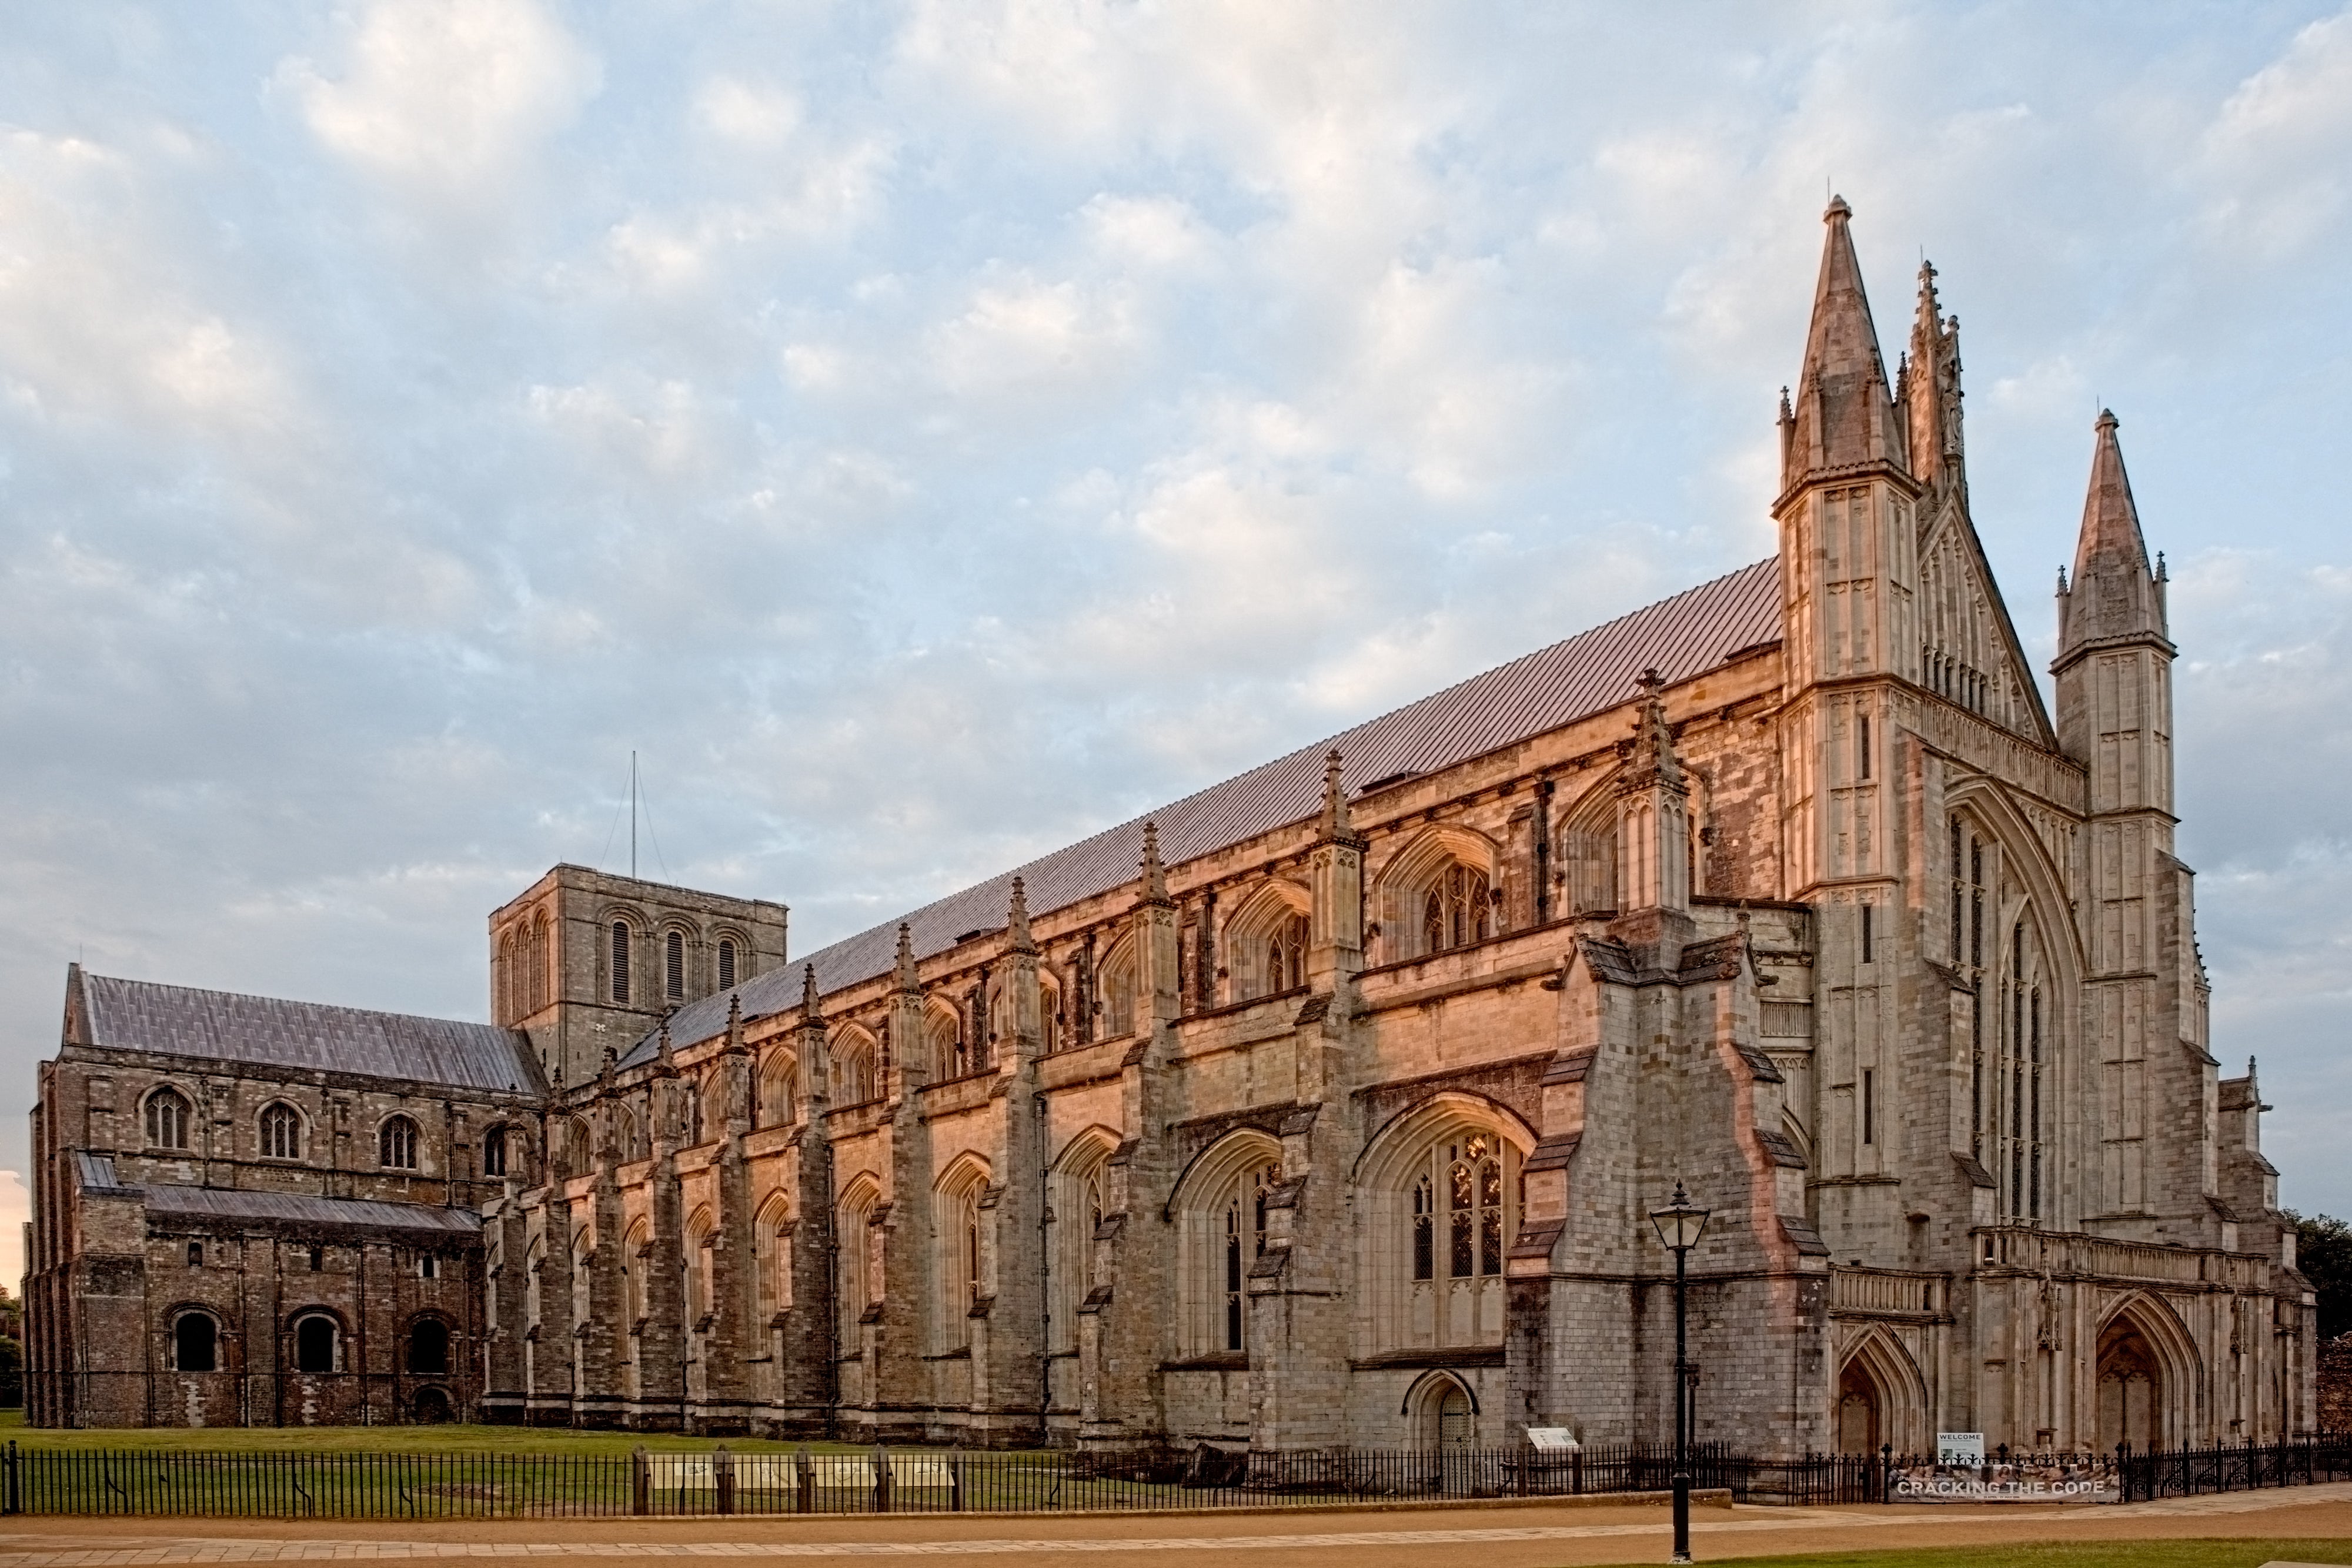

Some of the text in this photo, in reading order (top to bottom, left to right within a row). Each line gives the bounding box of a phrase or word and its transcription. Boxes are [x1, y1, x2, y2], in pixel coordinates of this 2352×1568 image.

[1897, 1481, 2104, 1495] CRACKING THE CODE
